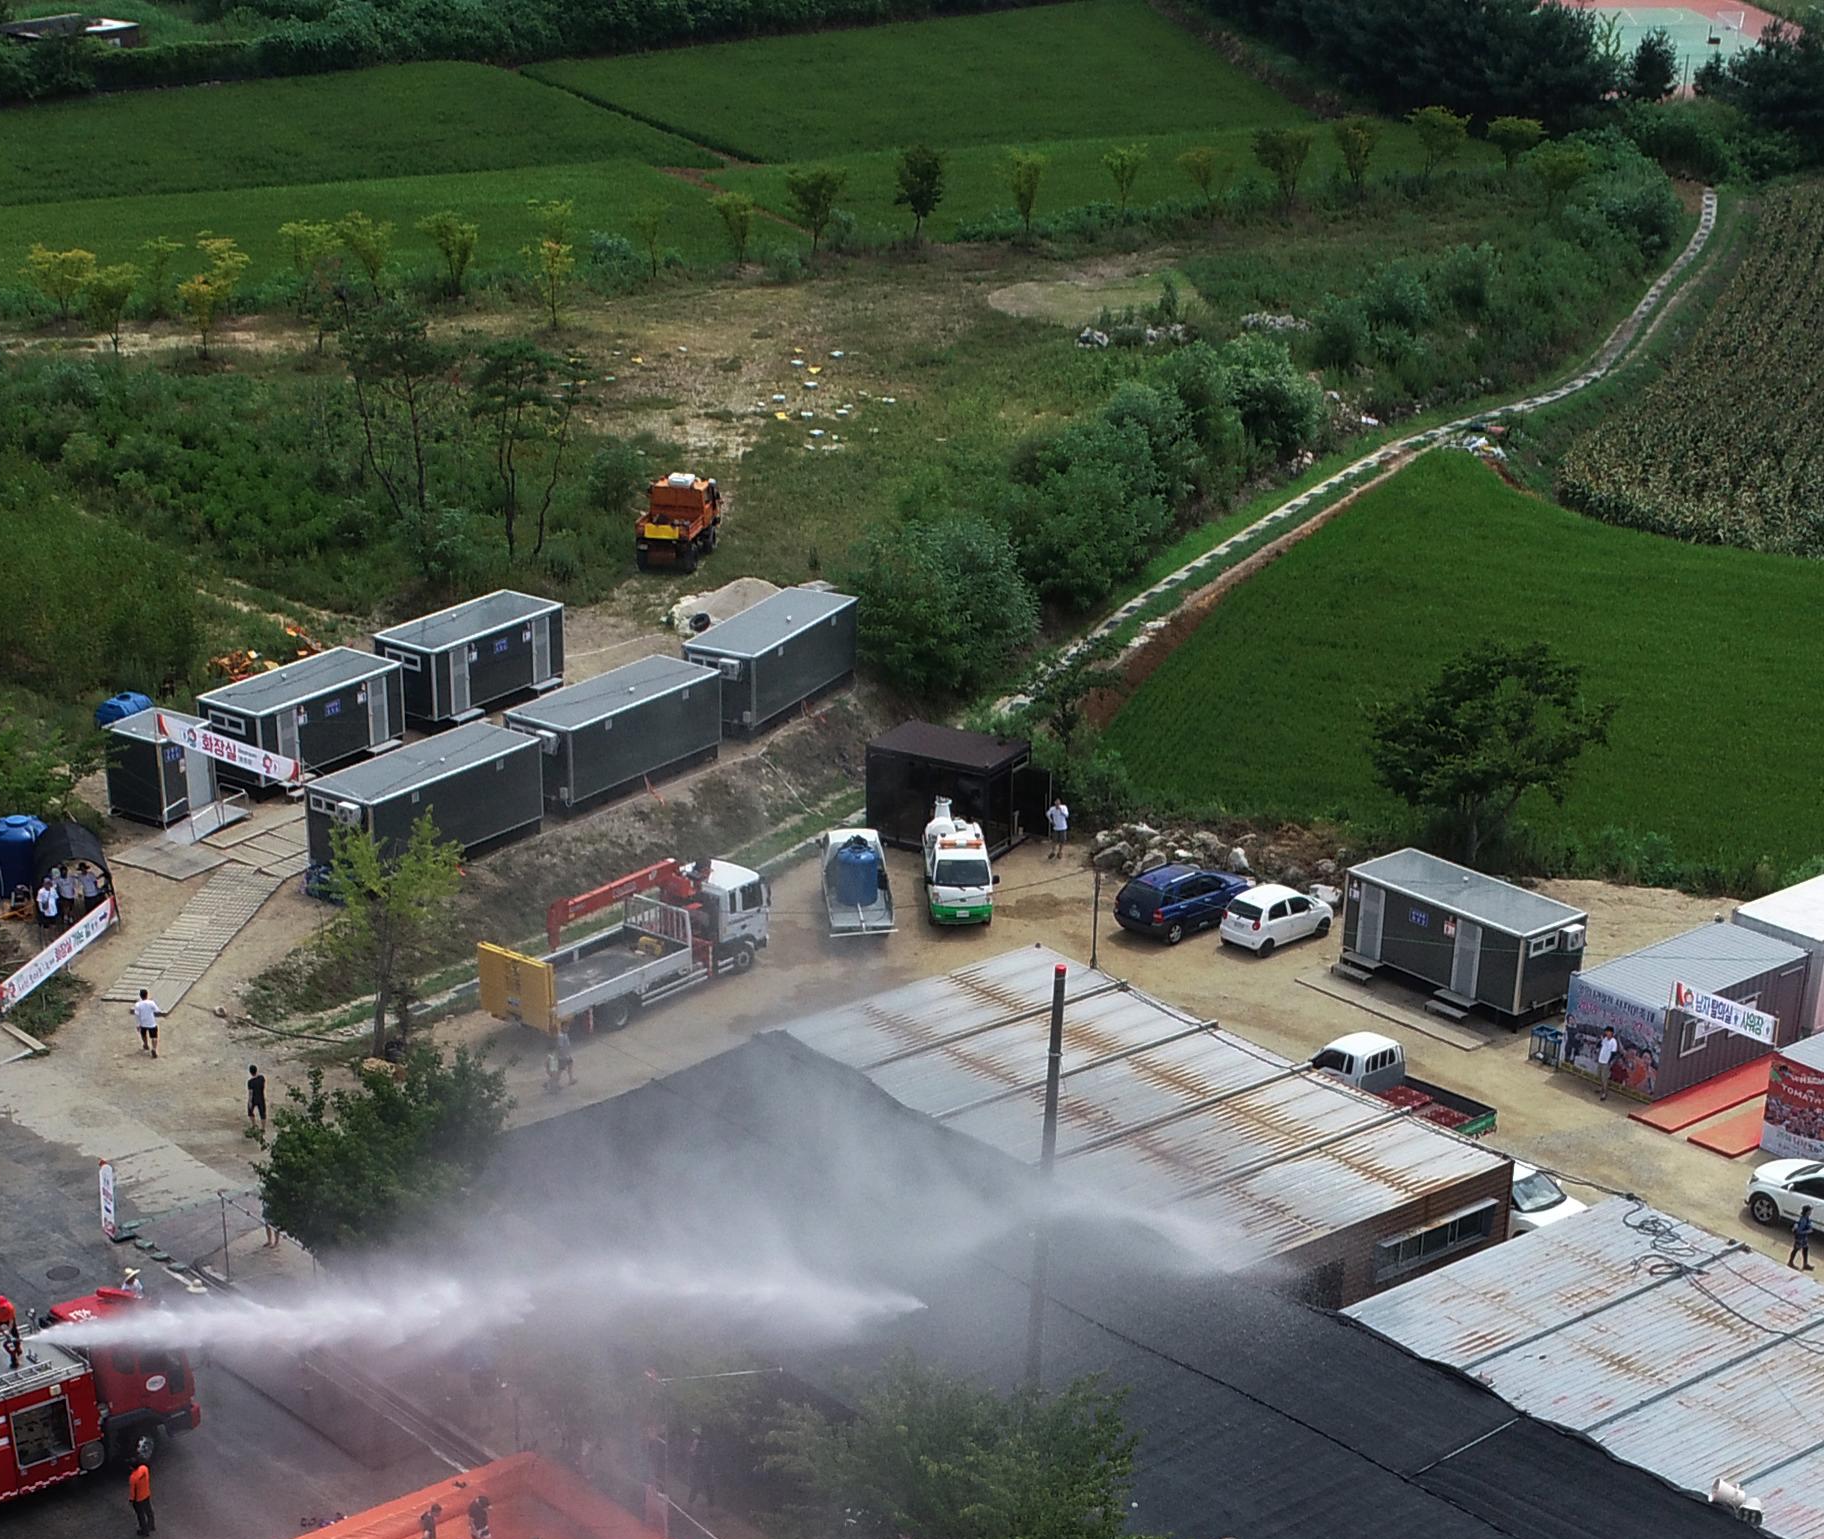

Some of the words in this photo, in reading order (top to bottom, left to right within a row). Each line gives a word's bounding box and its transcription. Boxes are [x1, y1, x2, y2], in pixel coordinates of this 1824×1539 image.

[201, 734, 238, 762] 화장실
[1695, 992, 1710, 1016] 남자
[1710, 998, 1734, 1025] 탈의실
